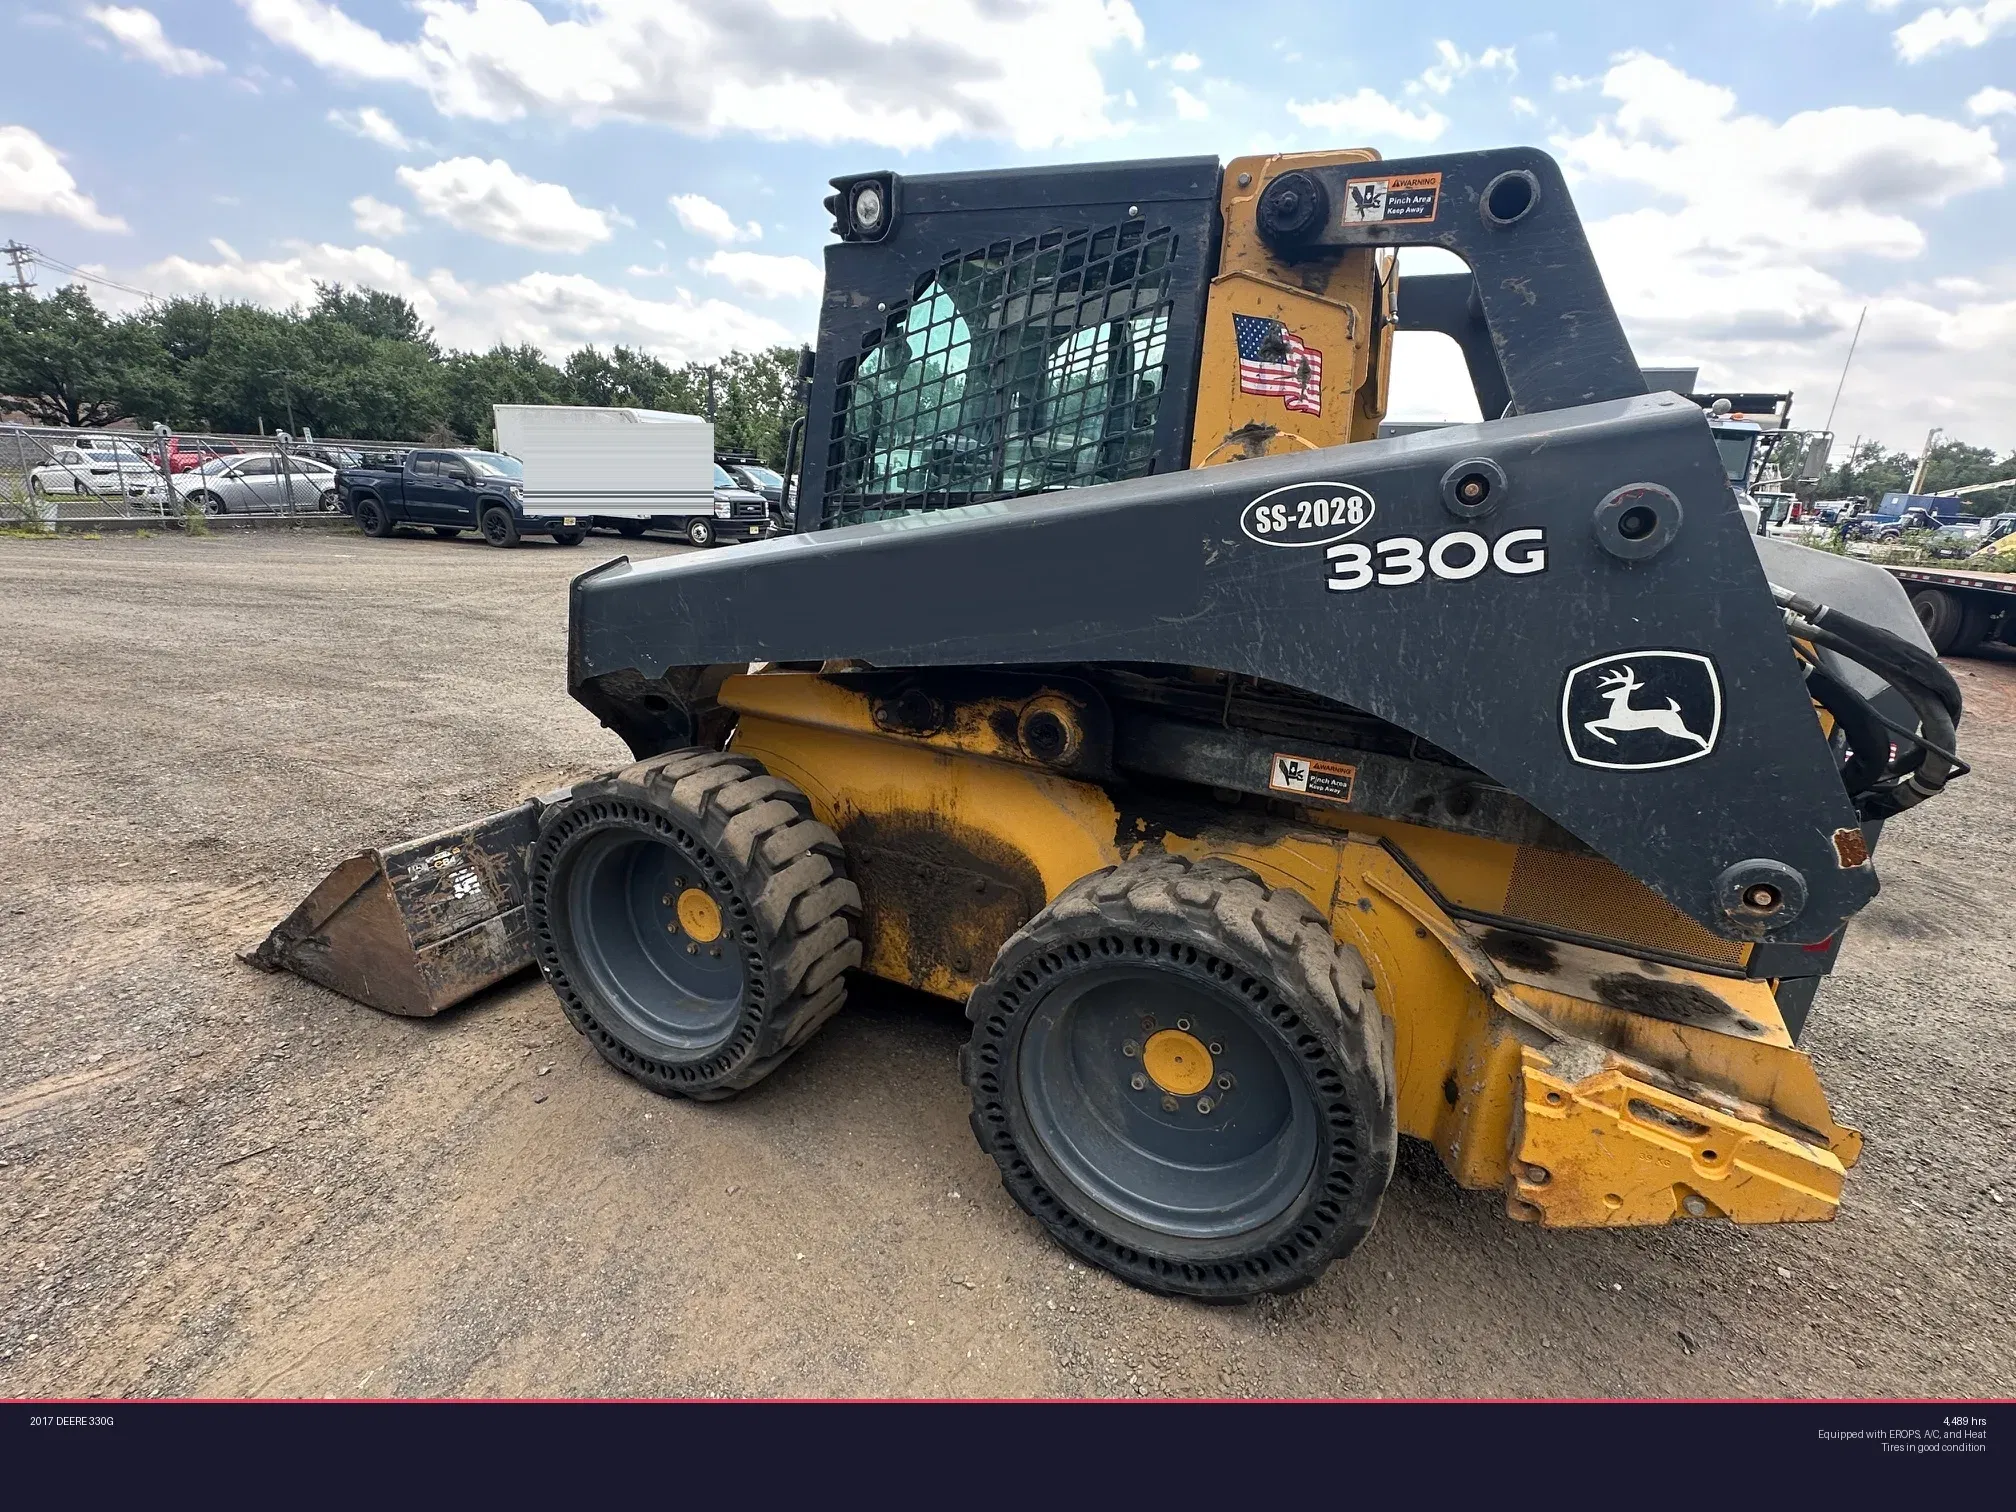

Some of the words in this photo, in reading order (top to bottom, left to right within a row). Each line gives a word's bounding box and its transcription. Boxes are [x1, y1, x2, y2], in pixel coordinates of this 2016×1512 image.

[1400, 177, 1436, 188] WARNING
[1389, 195, 1411, 205] Pinch
[1412, 195, 1432, 204] Area
[1387, 207, 1405, 216] Keep
[1406, 206, 1424, 214] Away
[1255, 495, 1364, 535] SS-2028
[1325, 527, 1546, 592] 330G
[1320, 764, 1352, 775] WARNING
[1310, 775, 1330, 784] Pinch
[1331, 780, 1347, 788] Area
[1309, 783, 1324, 791] Keep
[1325, 786, 1341, 795] Away
